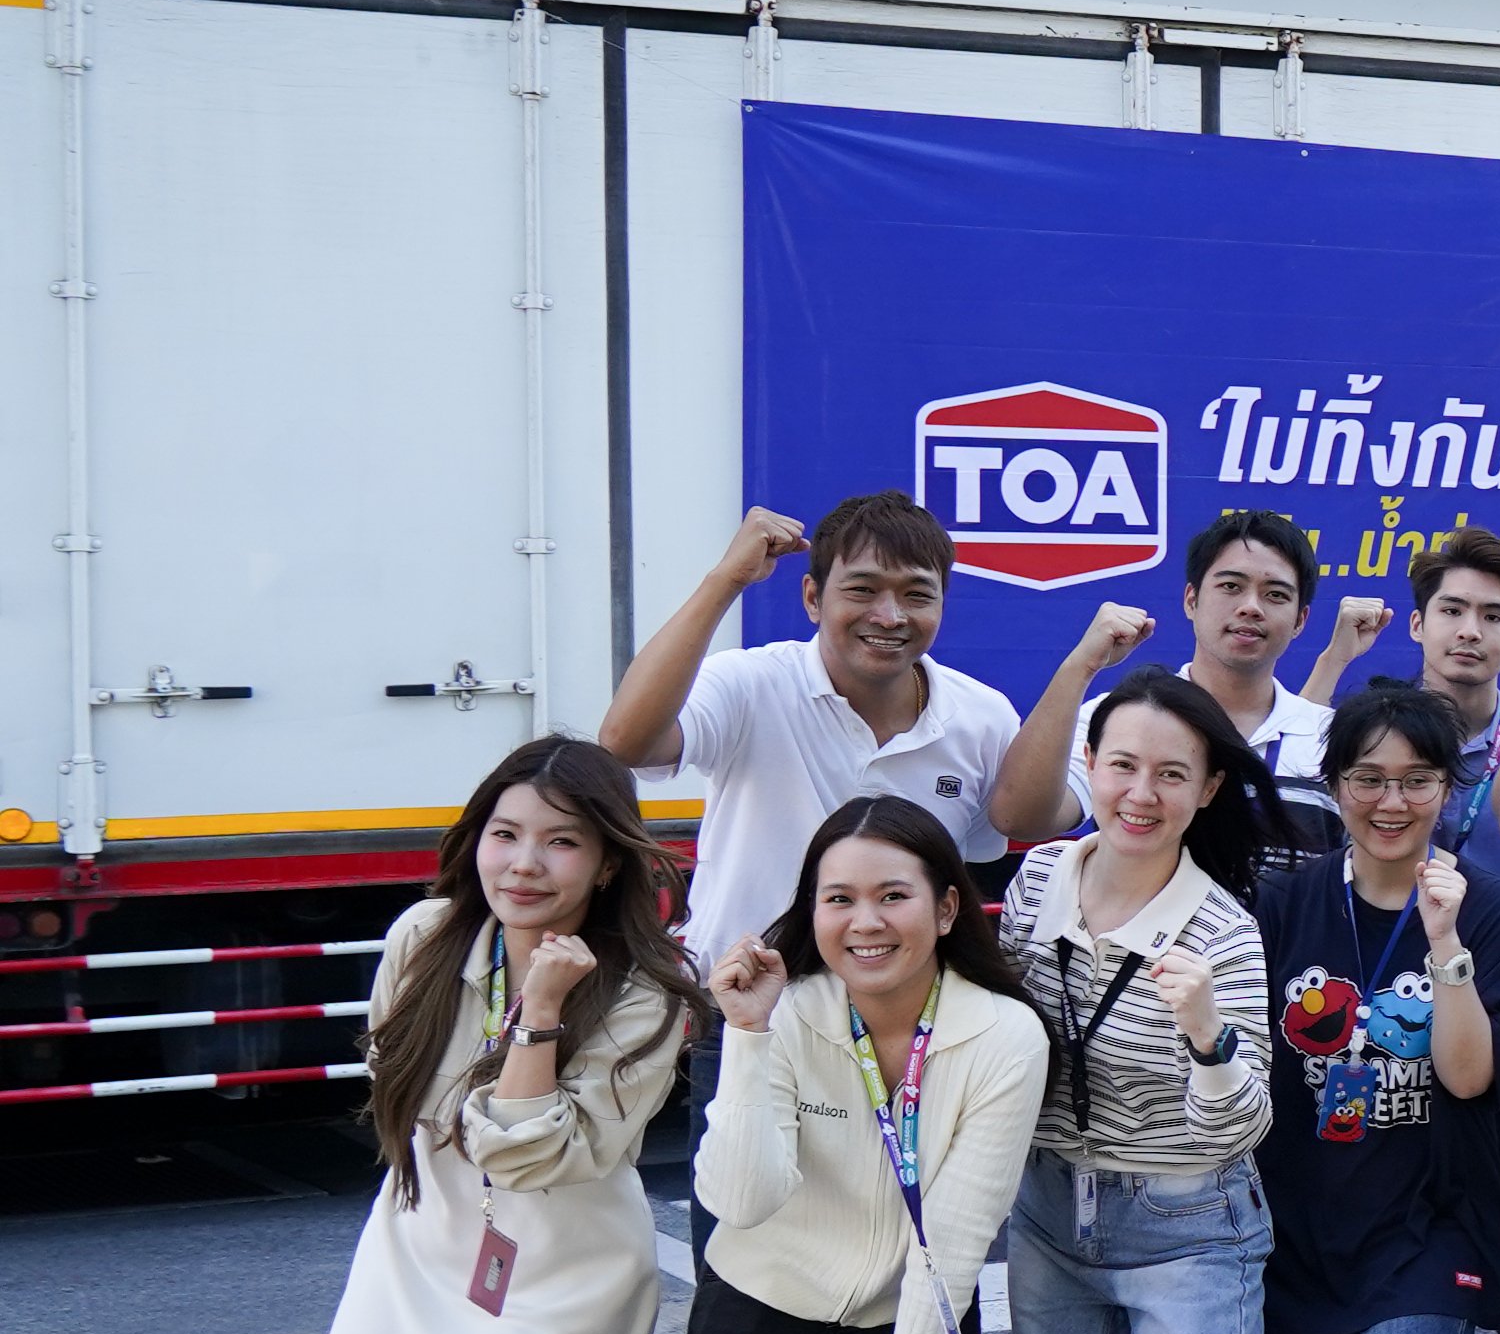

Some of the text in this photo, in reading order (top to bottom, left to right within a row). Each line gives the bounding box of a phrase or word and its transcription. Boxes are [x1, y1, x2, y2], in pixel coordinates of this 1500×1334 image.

[933, 445, 1149, 526] TOA
[939, 781, 959, 793] TOA
[1305, 1056, 1433, 1090] SAME
